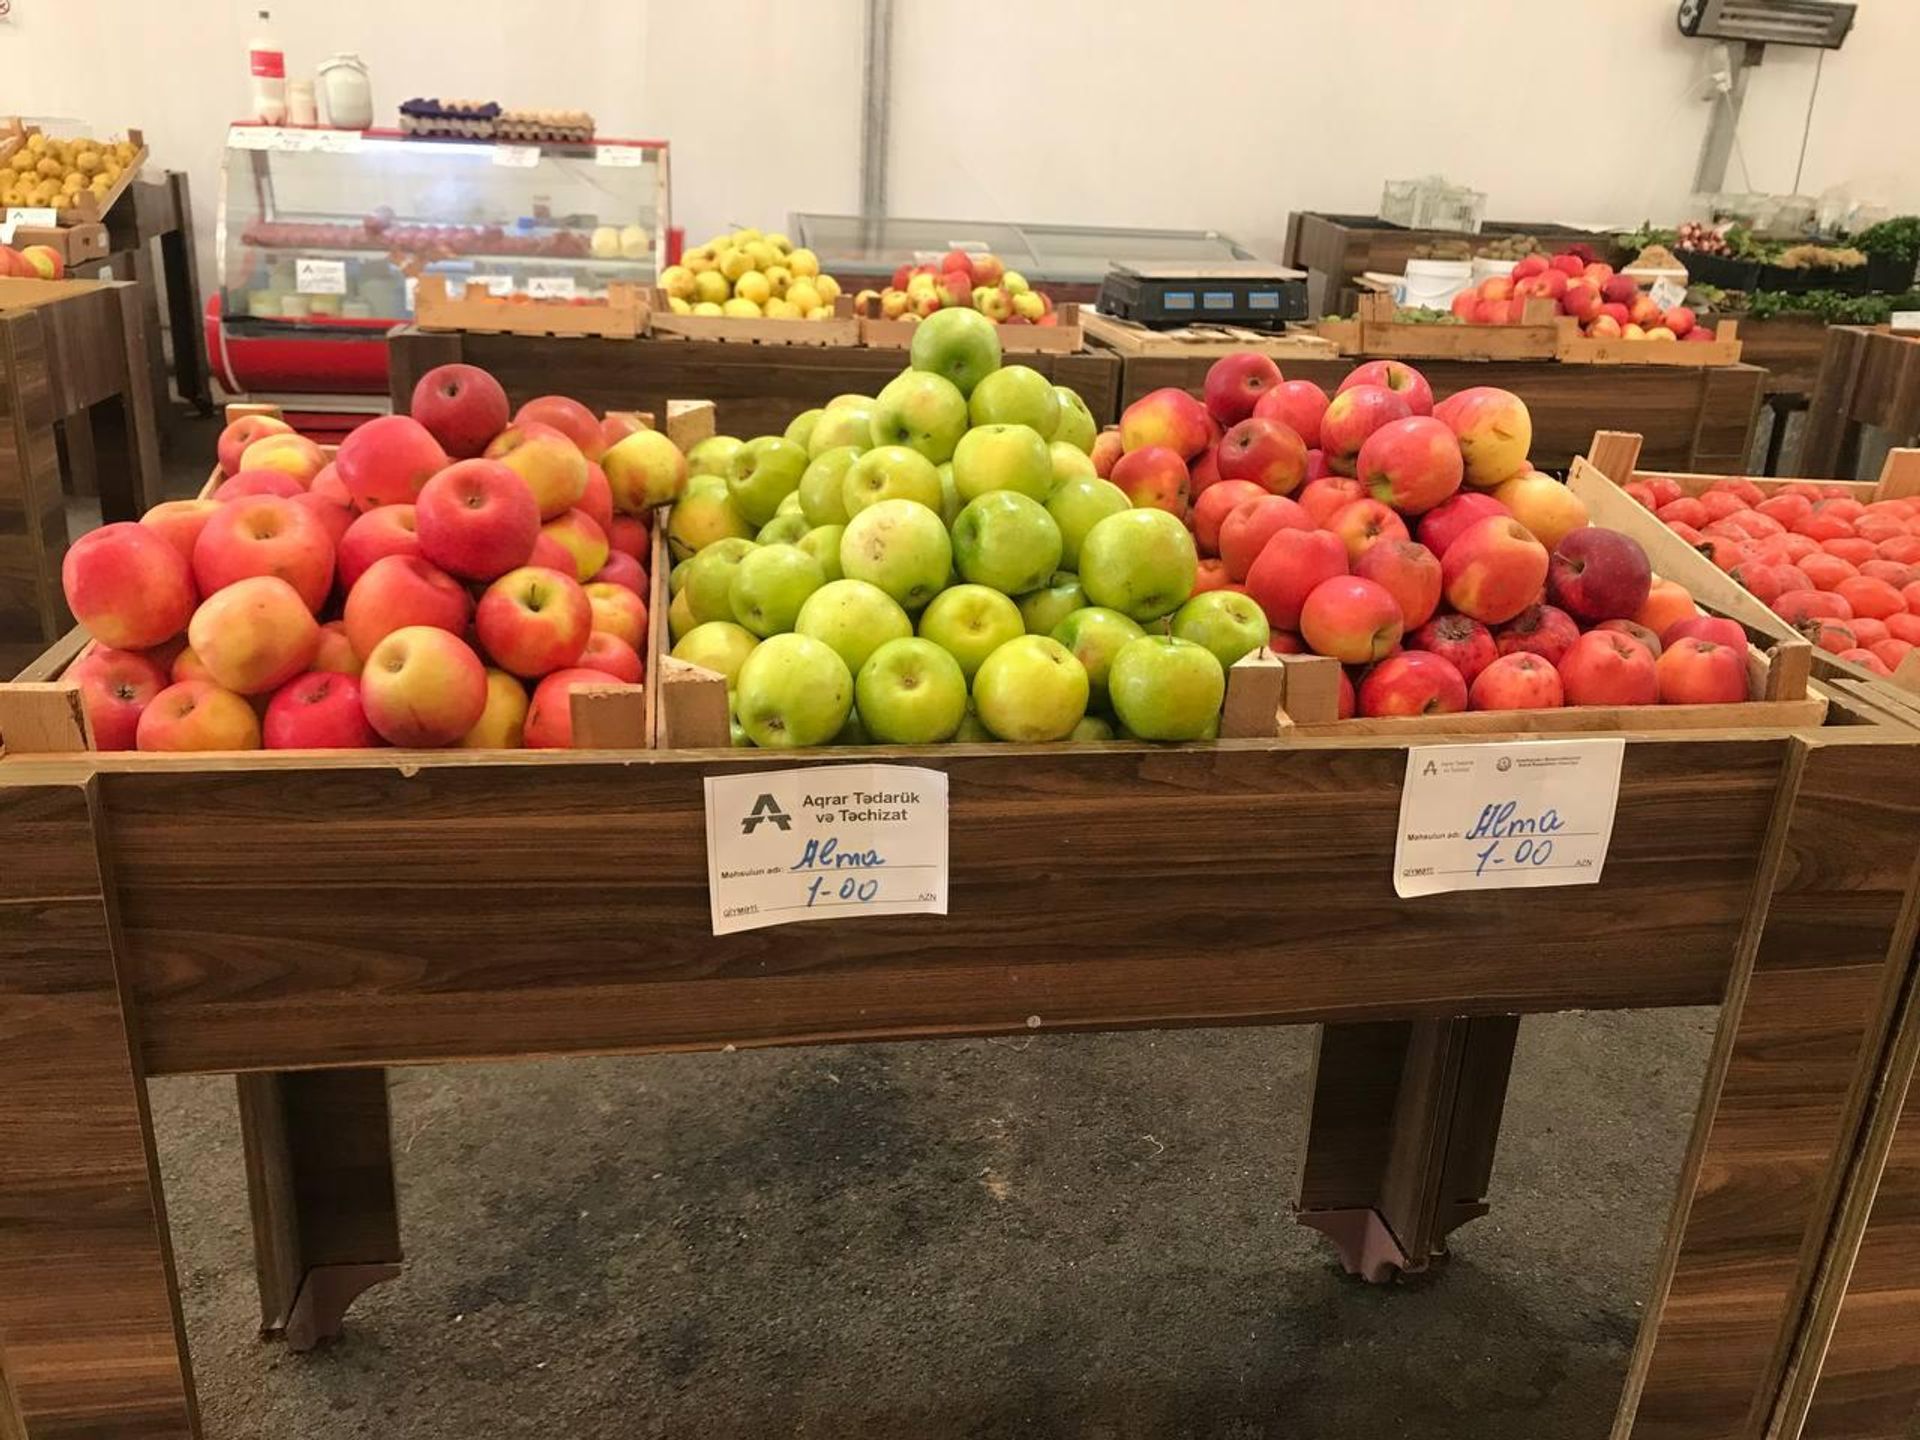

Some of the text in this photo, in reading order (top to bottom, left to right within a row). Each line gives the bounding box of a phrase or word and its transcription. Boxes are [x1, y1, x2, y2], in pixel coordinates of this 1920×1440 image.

[802, 791, 920, 809] Aqrar Tədarük
[816, 808, 908, 823] və Təchizat
[1465, 800, 1566, 840] Alma
[790, 837, 886, 870] Alma
